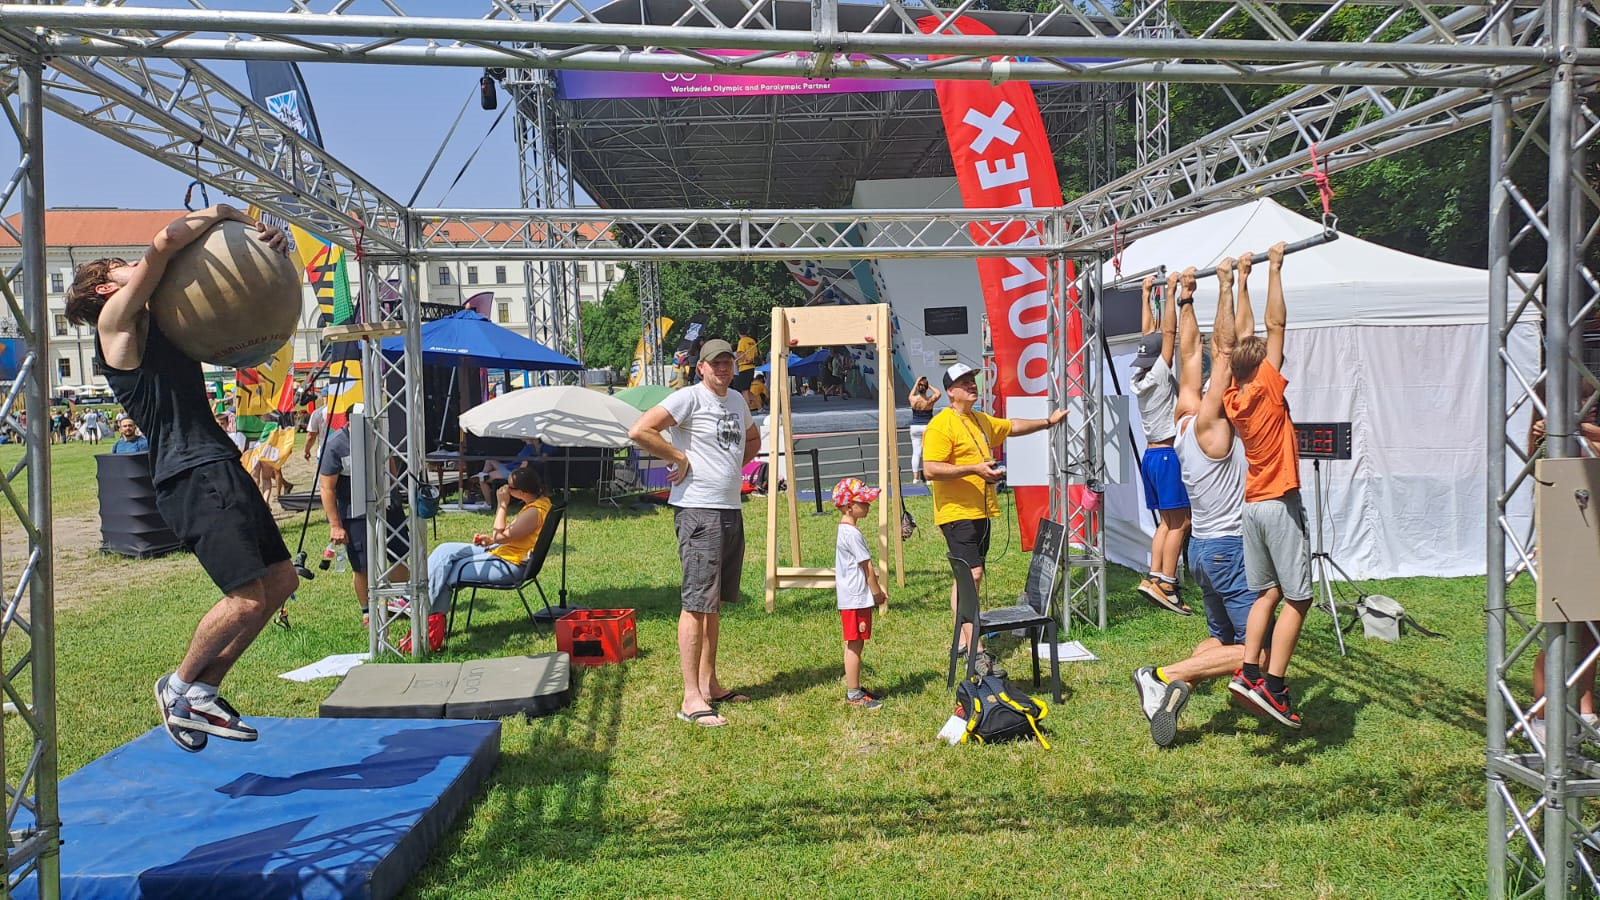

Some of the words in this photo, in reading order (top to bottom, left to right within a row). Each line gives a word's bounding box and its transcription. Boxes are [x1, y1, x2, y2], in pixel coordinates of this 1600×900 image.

[671, 85, 712, 93] Worldwide
[713, 84, 743, 92] Olympic
[760, 83, 802, 91] Paralympic
